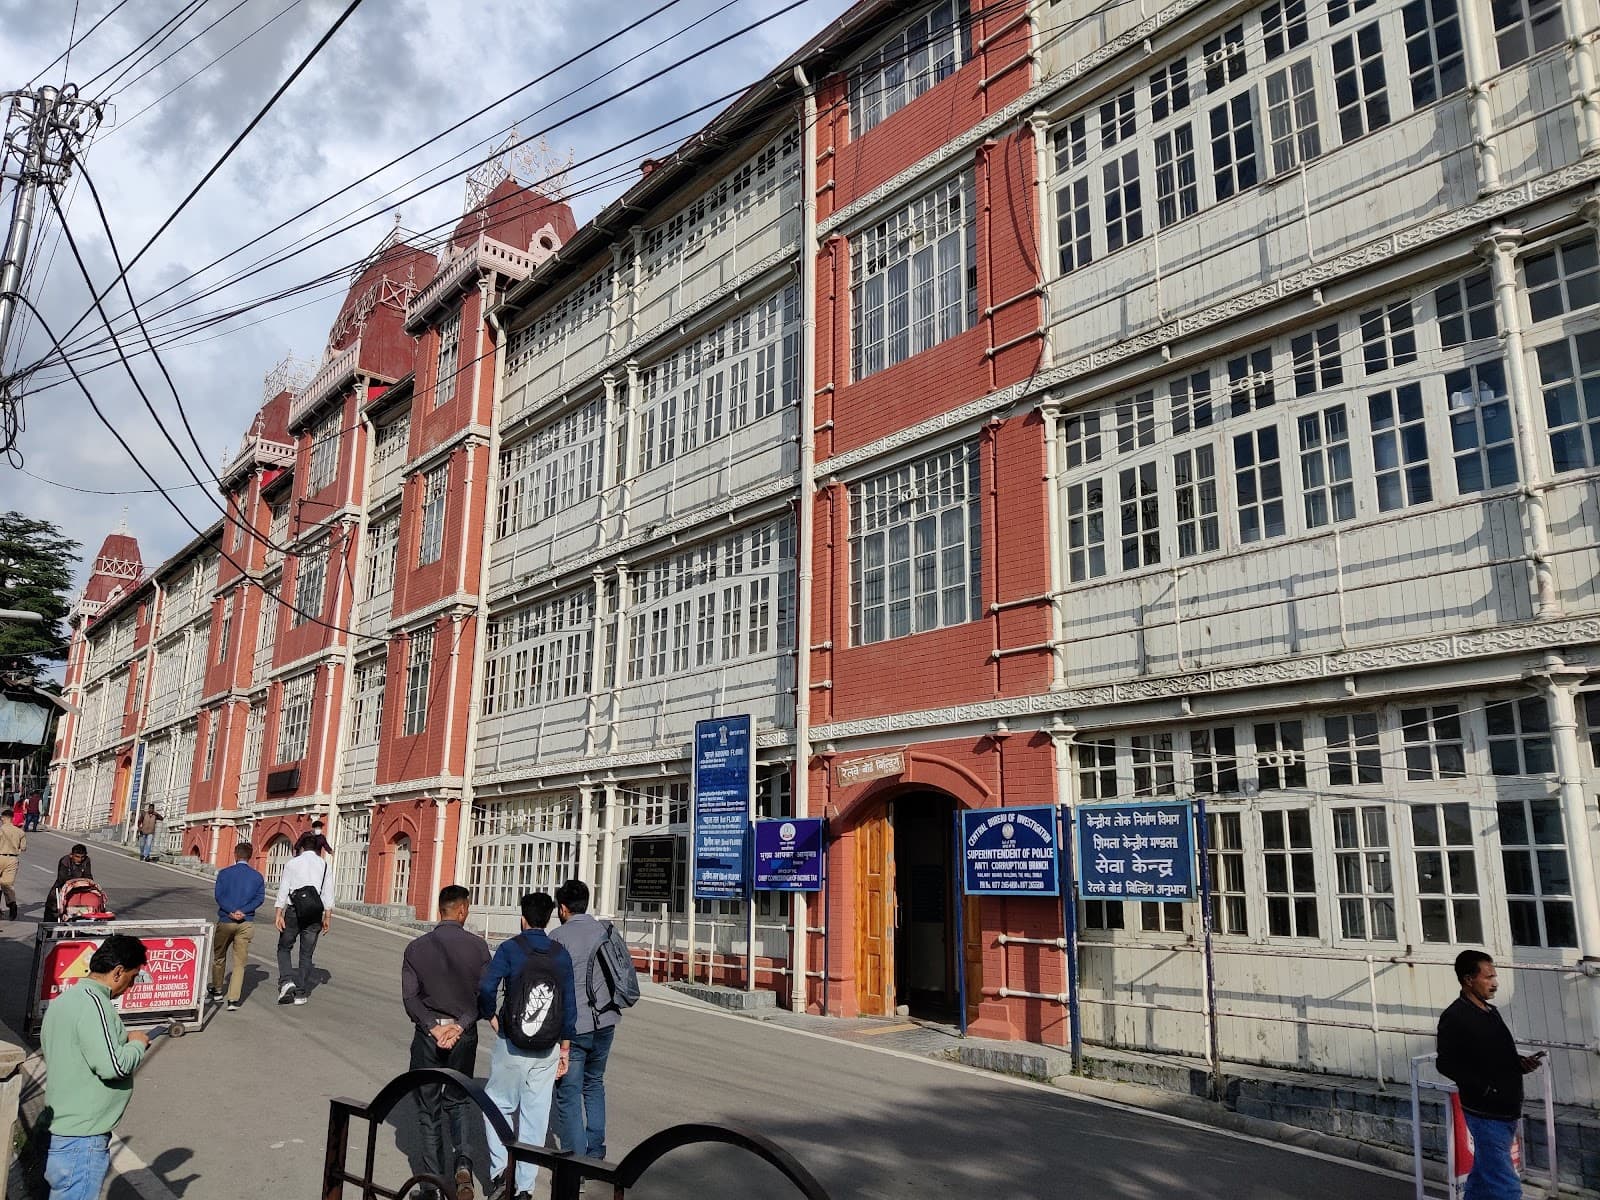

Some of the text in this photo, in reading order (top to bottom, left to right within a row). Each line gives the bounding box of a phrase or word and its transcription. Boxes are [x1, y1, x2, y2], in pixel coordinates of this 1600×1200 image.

[1086, 813, 1111, 829] केन्द्रीय
[1113, 812, 1131, 827] लोक
[1133, 811, 1156, 826] निर्माण
[968, 813, 1053, 847] CENTRAL BUREAU OF INVESTIGATION
[1093, 834, 1120, 851] शिमला
[1122, 834, 1148, 851] केन्द्रीय
[967, 848, 1053, 860] SUPERINTENDENT OF POLICE
[974, 861, 1049, 870] ANTI CORRUPTION BRANCH
[1095, 853, 1173, 878] सेवा केन्द्र
[1087, 880, 1106, 893] रेलवे
[1156, 884, 1187, 897] अनुभाग
[147, 949, 195, 963] LIFFTON
[147, 960, 184, 973] VALLEY
[142, 984, 154, 992] BHK
[155, 982, 189, 991] RESIDENCES
[132, 992, 153, 1000] STUDIO
[153, 990, 190, 999] APARTMENTS
[125, 1001, 143, 1009] CALL
